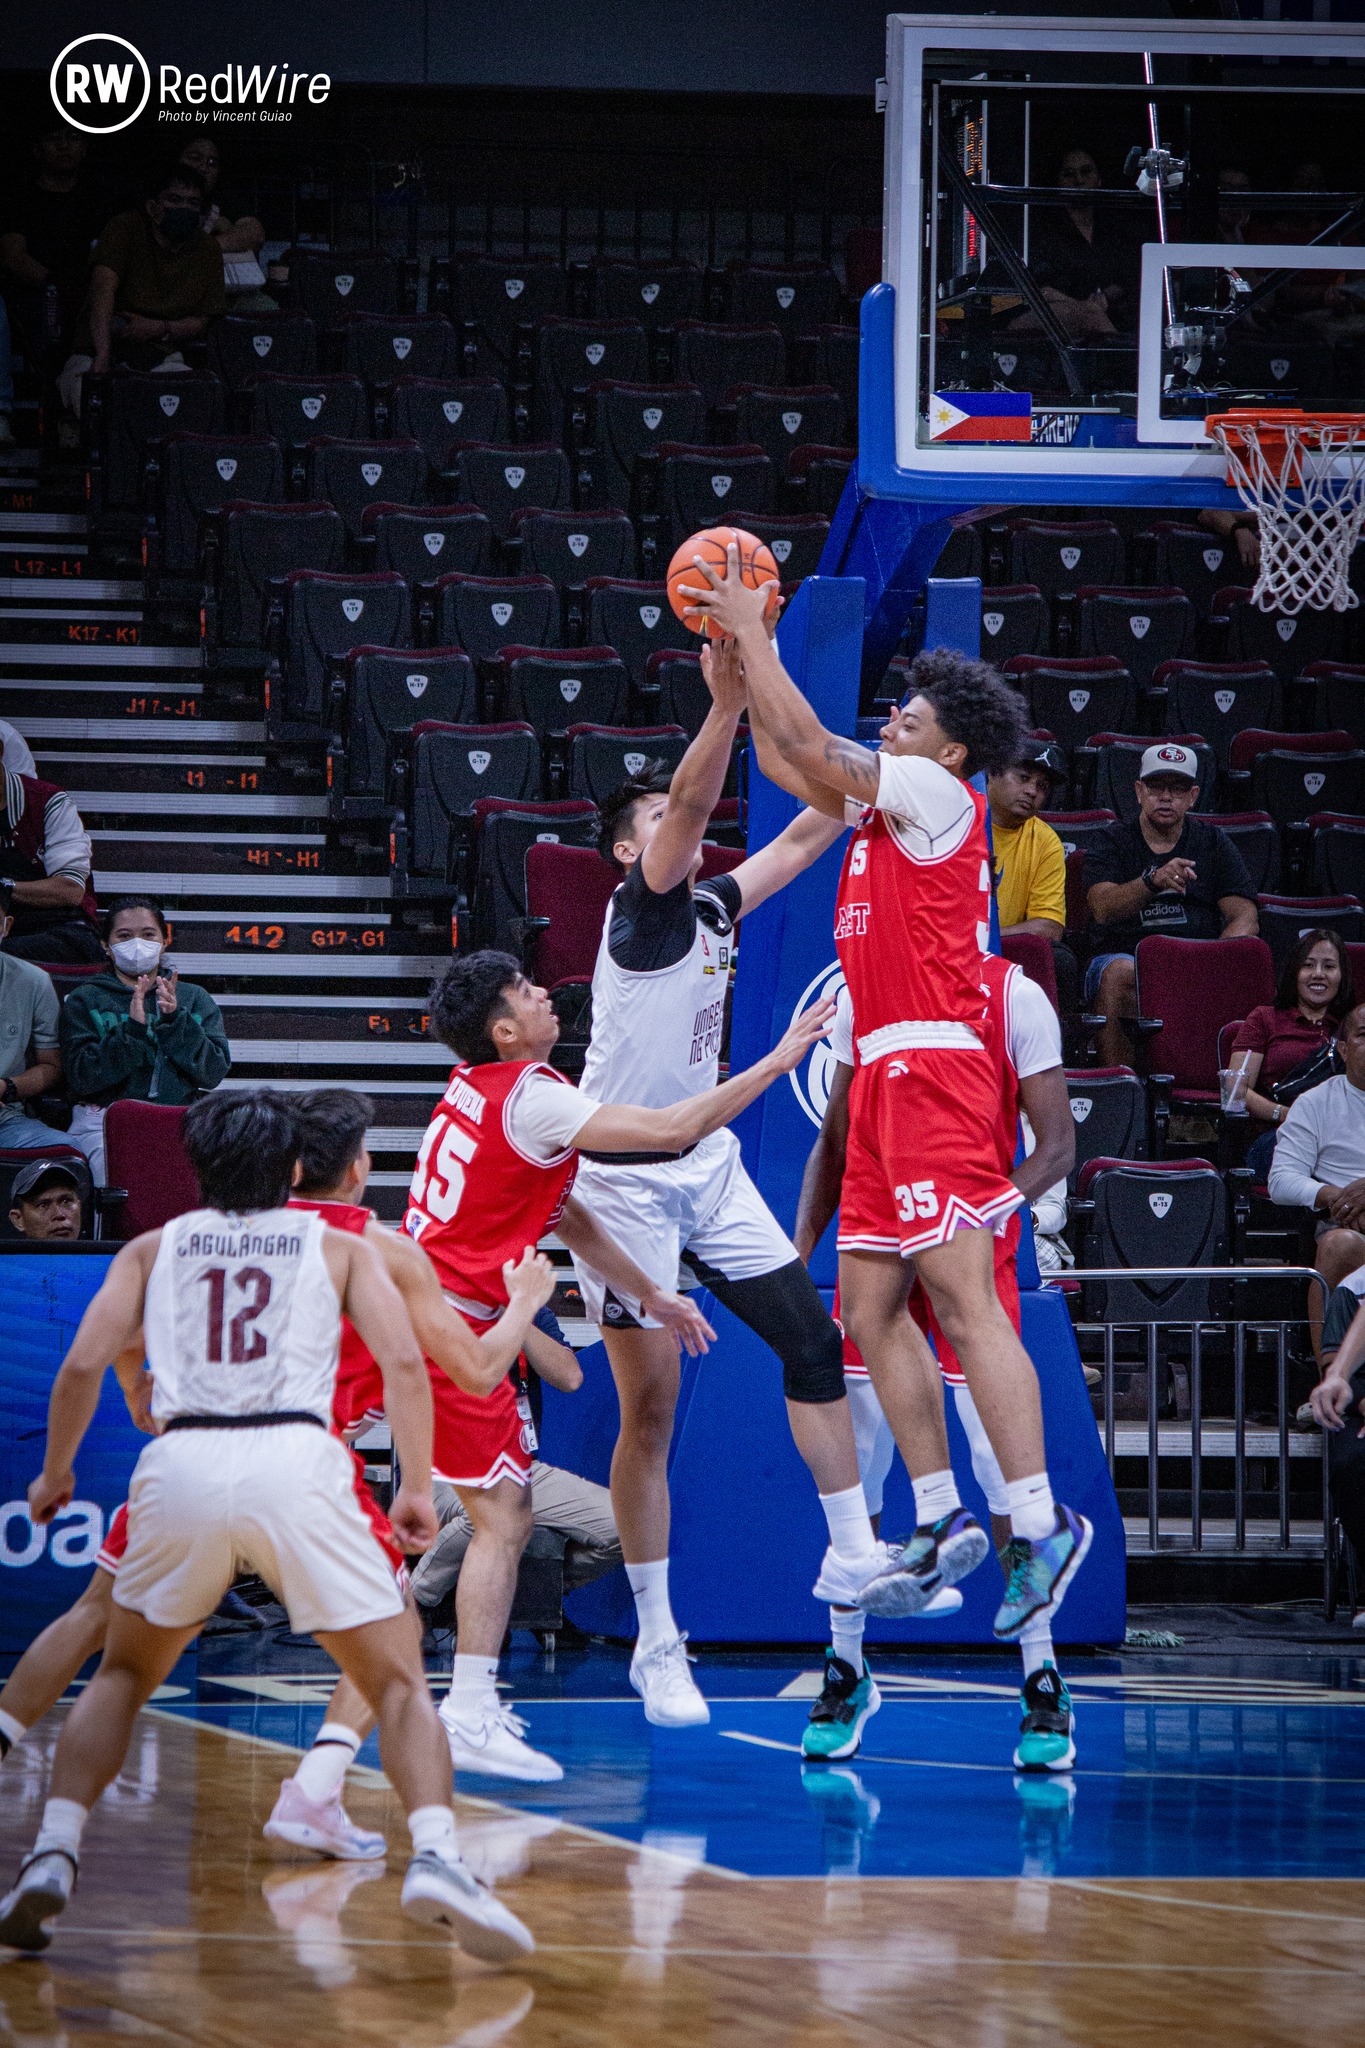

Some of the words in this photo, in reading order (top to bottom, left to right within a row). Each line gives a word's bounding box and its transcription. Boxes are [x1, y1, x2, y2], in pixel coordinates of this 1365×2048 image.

[68, 625, 100, 641] K17
[116, 627, 138, 644] K1
[175, 699, 196, 715] J1
[296, 851, 319, 868] H1
[1144, 903, 1181, 918] adidas
[226, 925, 285, 949] 112
[311, 930, 347, 946] G17
[361, 930, 385, 947] G1
[407, 1111, 479, 1224] 15
[894, 1180, 940, 1222] 35
[197, 1266, 272, 1365] 12
